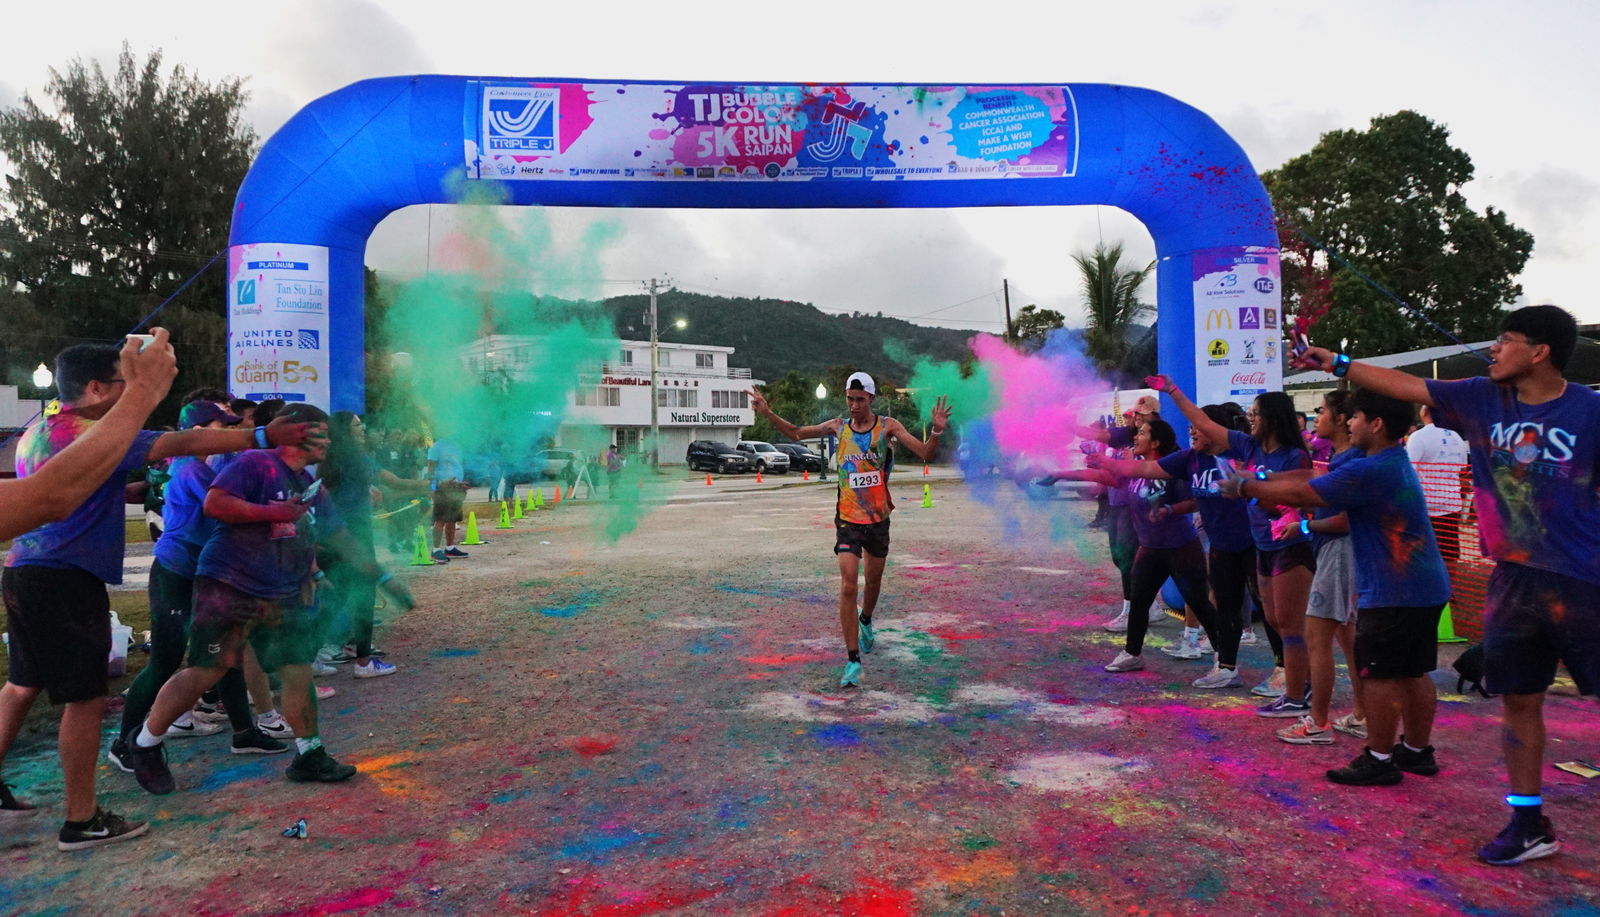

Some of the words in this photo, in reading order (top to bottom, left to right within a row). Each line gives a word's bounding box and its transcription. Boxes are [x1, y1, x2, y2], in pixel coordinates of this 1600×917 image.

[688, 93, 721, 122] TJ
[722, 92, 796, 107] BUBBLE
[965, 104, 1035, 120] COMMONWEALTH
[722, 105, 795, 124] COLOR
[959, 119, 991, 130] CANCER
[992, 111, 1045, 125] ASSOCIATION
[1005, 123, 1023, 132] AND
[743, 125, 792, 145] RUN
[978, 135, 1001, 146] MAKE
[1003, 134, 1009, 142] A
[1011, 131, 1032, 141] WISH
[491, 138, 538, 149] TRIPLE
[543, 139, 552, 149] J
[697, 126, 741, 158] 5K
[980, 141, 1032, 155] FOUNDATION
[745, 143, 793, 156] SAIPAN
[521, 166, 544, 174] Hertz
[875, 167, 907, 175] WHOLESALE
[276, 283, 292, 294] Tan
[293, 284, 307, 295] Siu
[308, 285, 323, 297] Lin
[276, 298, 323, 310] Foundation
[243, 329, 293, 338] UNITED
[235, 339, 294, 349] AIRLINES
[245, 360, 265, 371] Bank
[267, 360, 278, 371] of
[235, 365, 279, 384] Guam
[609, 376, 637, 386] Beautiful
[671, 412, 700, 423] Natural
[701, 412, 740, 425] Superstore
[852, 474, 879, 487] 1293
